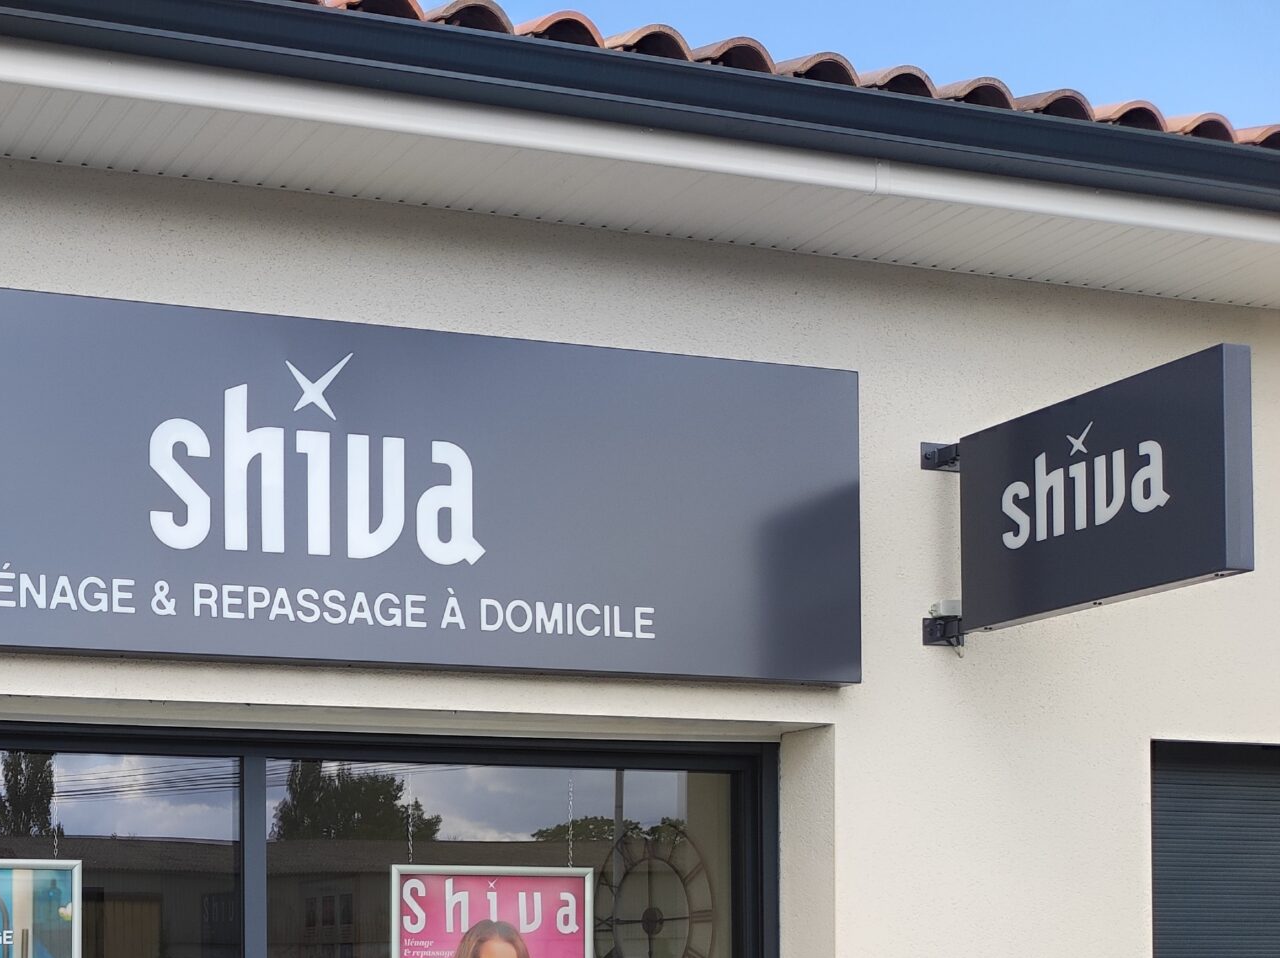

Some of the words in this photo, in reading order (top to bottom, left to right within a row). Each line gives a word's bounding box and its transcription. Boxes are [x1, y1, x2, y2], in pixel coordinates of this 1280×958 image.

[149, 352, 486, 565] shiva
[1001, 420, 1170, 550] shiva
[151, 580, 177, 616] &
[194, 584, 427, 628] REPASSAGE
[440, 588, 466, 630] À
[480, 598, 656, 639] DOMICILE
[402, 878, 580, 934] Shiva
